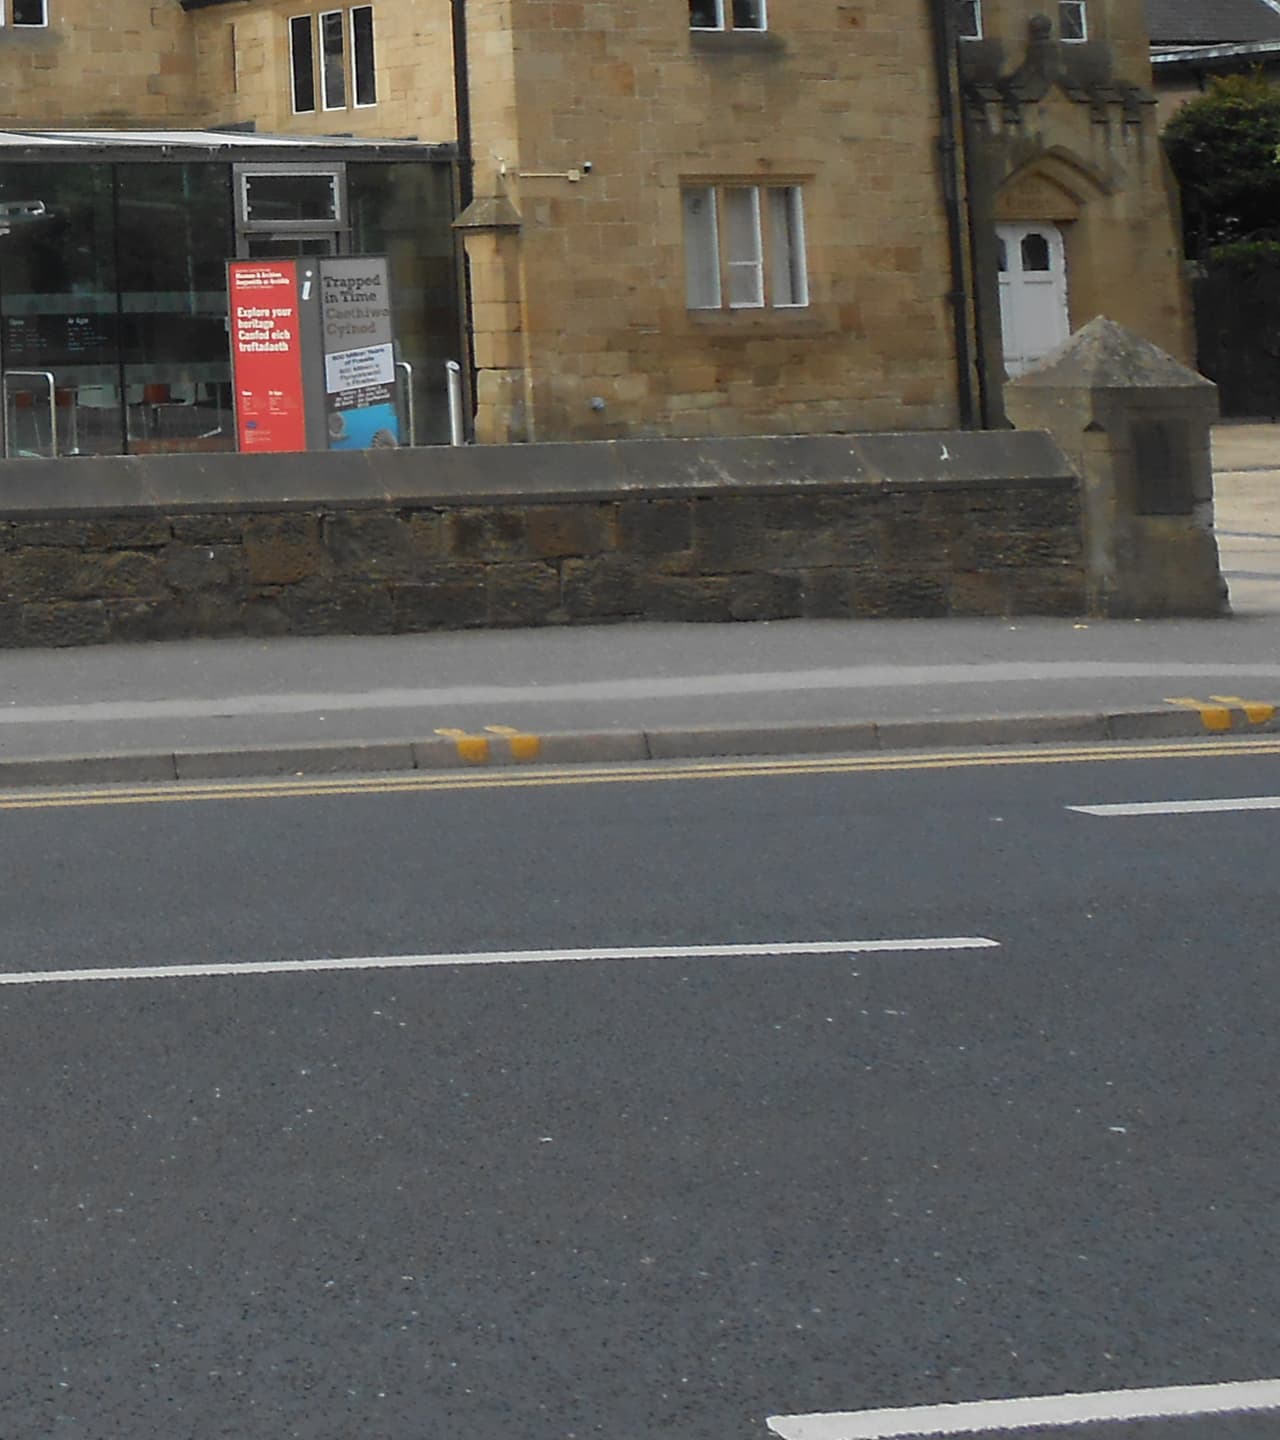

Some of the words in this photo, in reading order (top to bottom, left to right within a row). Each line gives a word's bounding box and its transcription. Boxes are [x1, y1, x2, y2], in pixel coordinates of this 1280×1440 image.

[323, 274, 381, 290] Trapped
[325, 292, 338, 303] in
[340, 291, 377, 302] Time
[237, 307, 270, 318] Explore
[272, 308, 292, 318] your
[238, 319, 274, 329] heritage
[238, 330, 269, 339] Canfod
[271, 330, 290, 339] eich
[239, 341, 289, 352] treftadaeth
